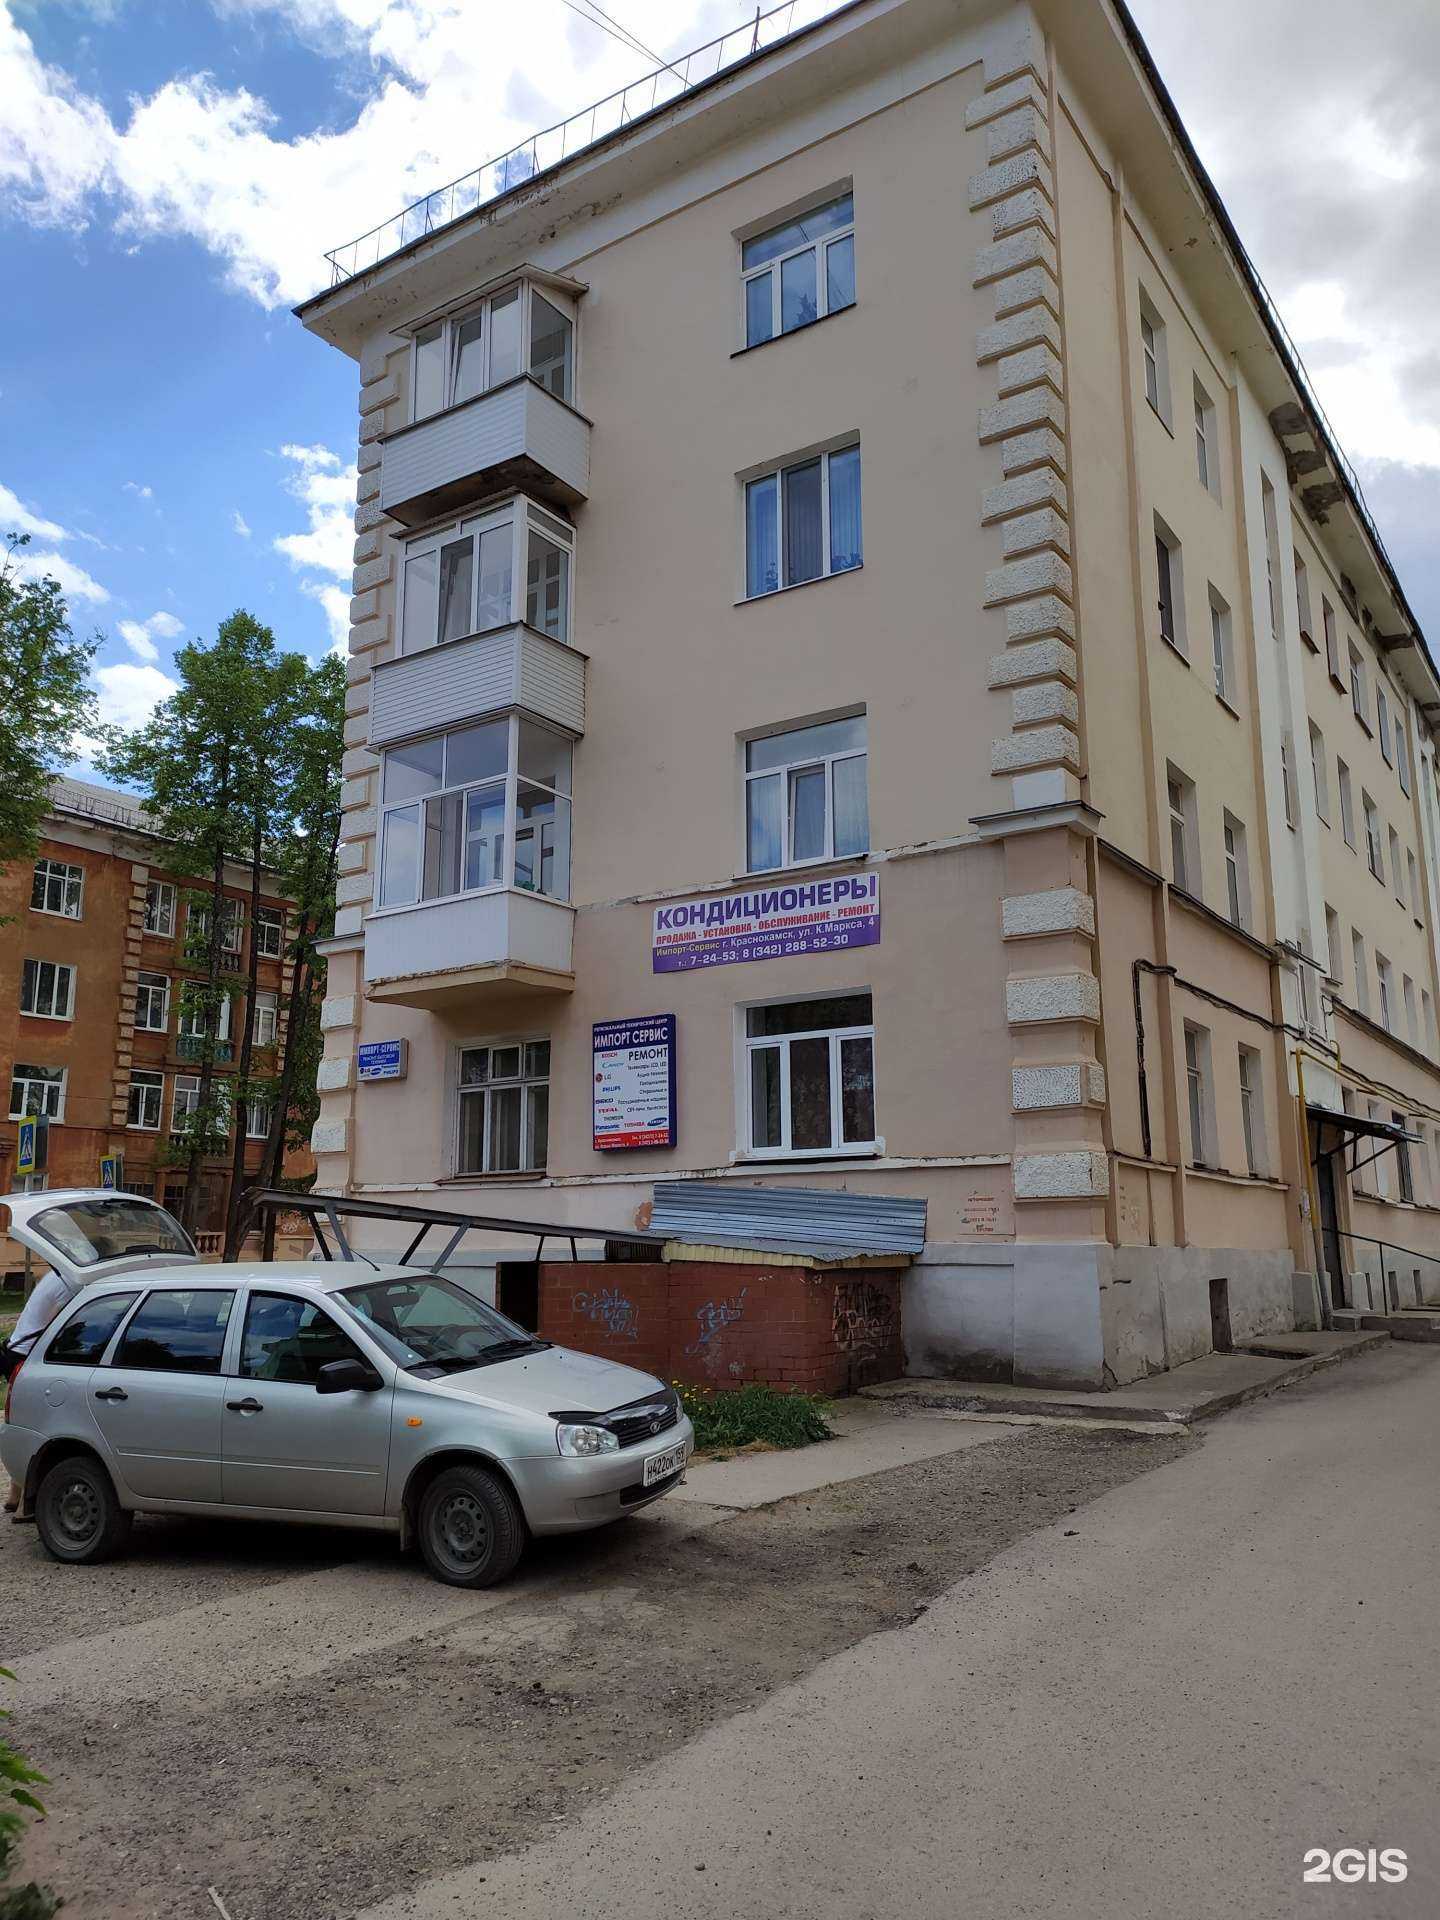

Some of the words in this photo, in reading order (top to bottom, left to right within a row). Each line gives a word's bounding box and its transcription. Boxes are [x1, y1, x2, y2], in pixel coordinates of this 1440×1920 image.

[657, 875, 876, 930] КОНДИЦИОНЕРЫ
[656, 931, 697, 945] ПРОДАЖА
[703, 922, 752, 938] УСТАНОВКА
[758, 910, 831, 930] ОБСЛУЖИВАНИЕ
[838, 903, 875, 918] РЕМОНТ
[656, 942, 720, 957] Импорт-Сервис
[731, 931, 796, 948] Краснокамск,
[868, 916, 875, 926] 4
[742, 948, 750, 958] 8
[752, 944, 782, 959] (342)
[785, 934, 849, 953] 288-52-30
[594, 1031, 631, 1048] ИМПОРТ
[632, 1027, 668, 1044] СЕРВИС
[629, 1047, 667, 1061] РЕМОНТ
